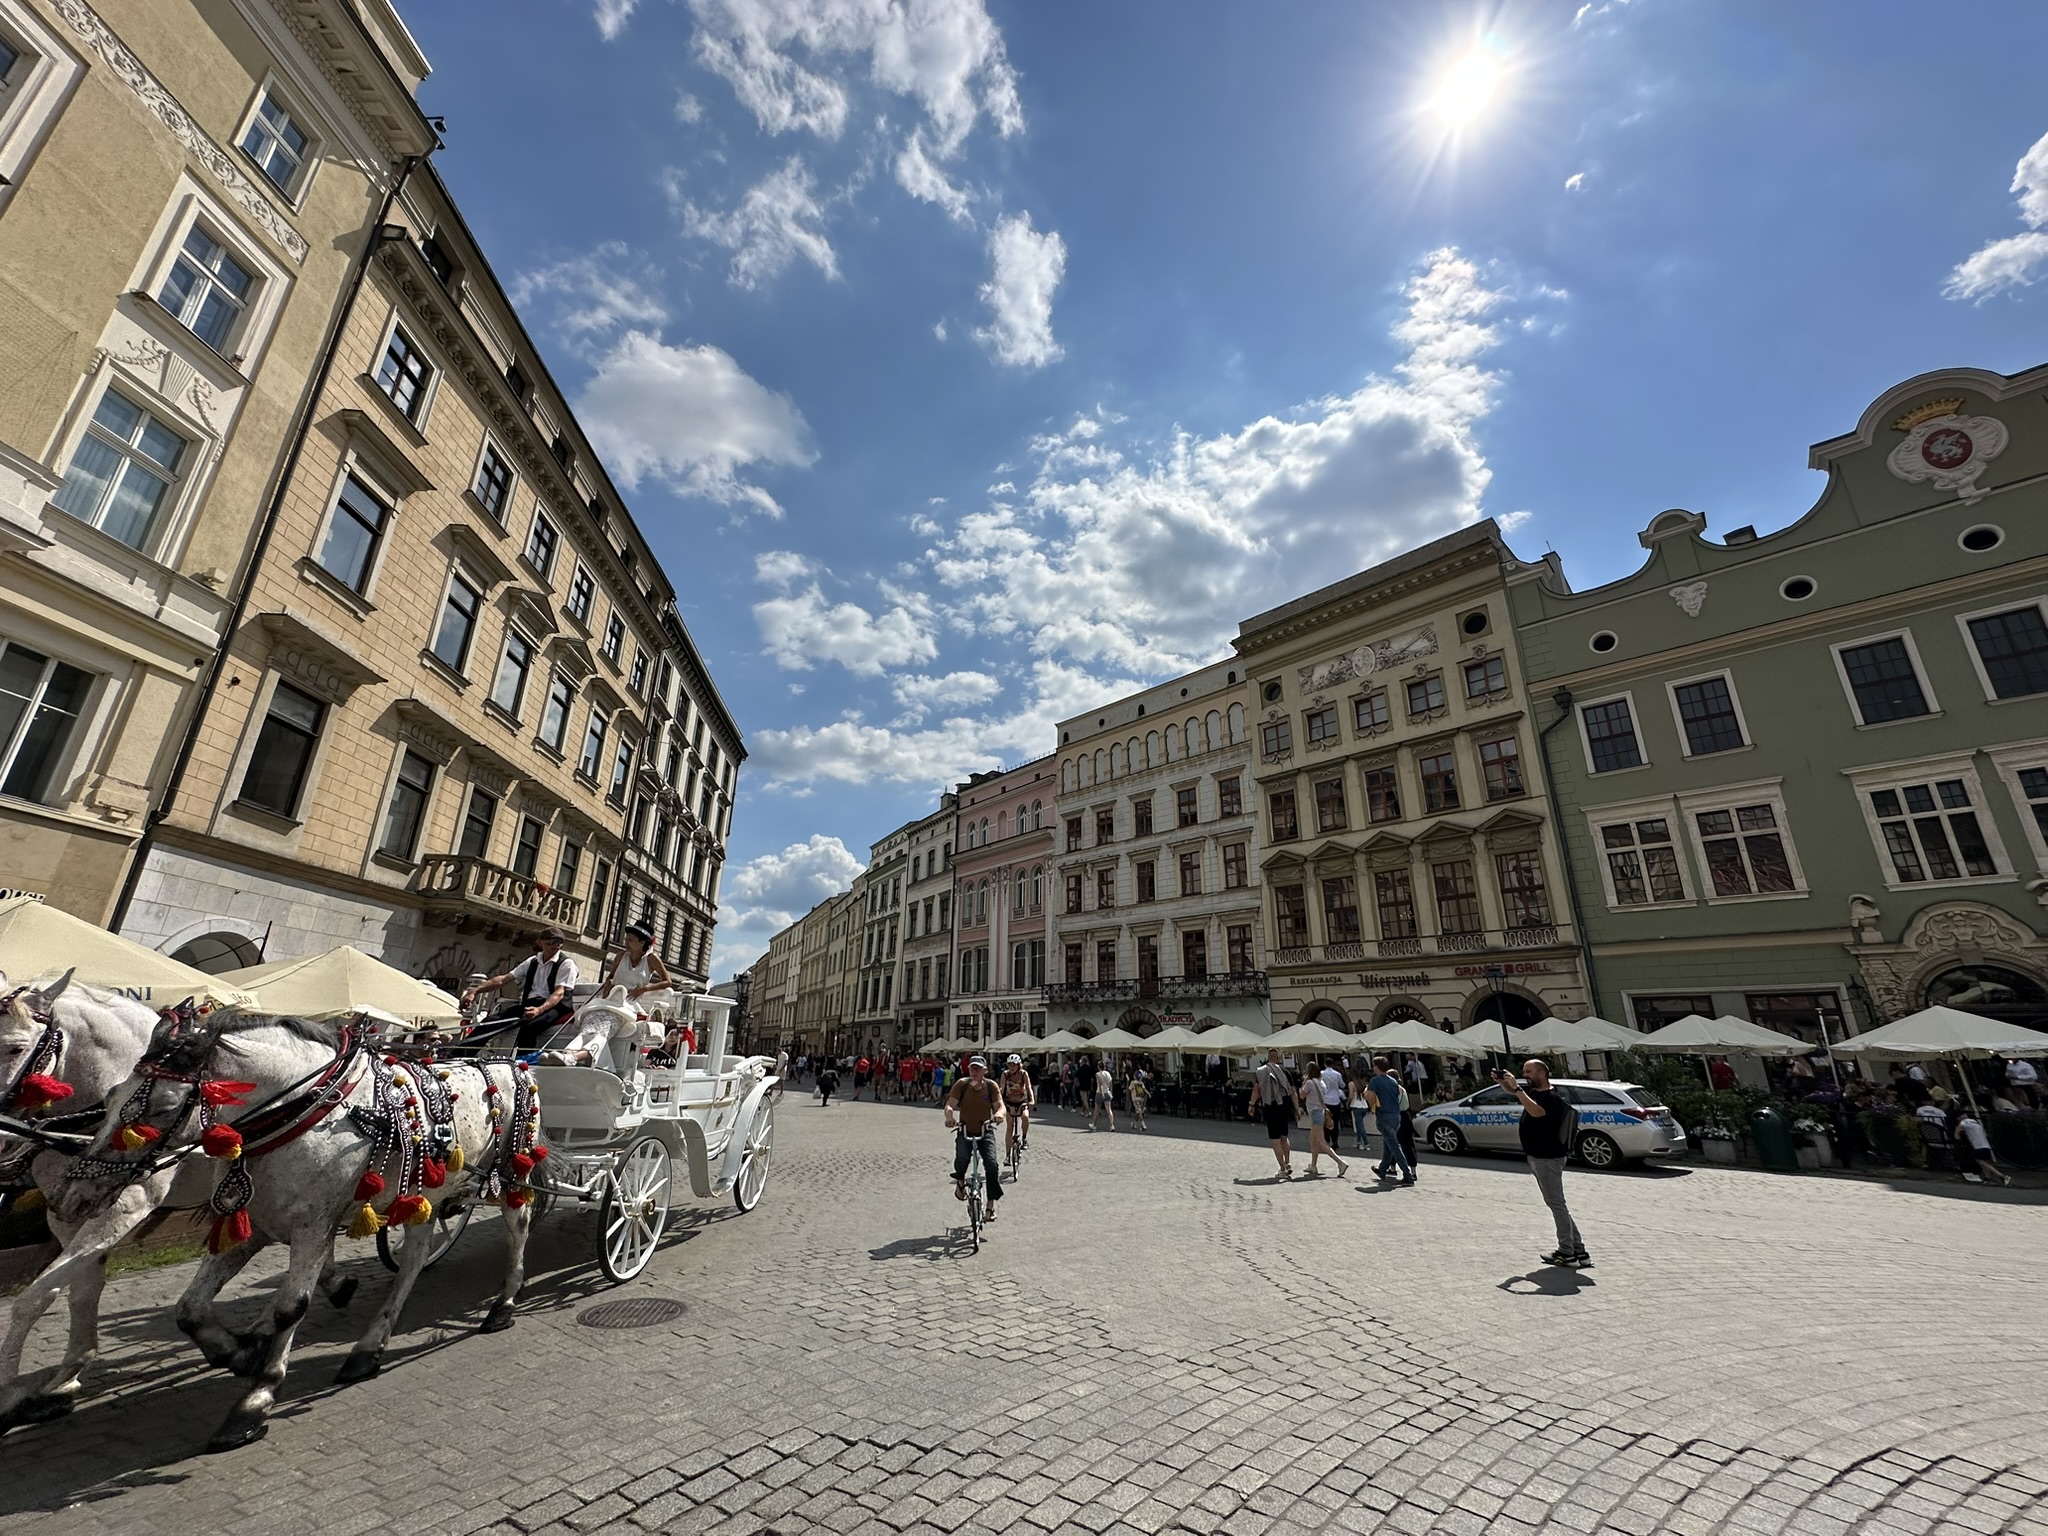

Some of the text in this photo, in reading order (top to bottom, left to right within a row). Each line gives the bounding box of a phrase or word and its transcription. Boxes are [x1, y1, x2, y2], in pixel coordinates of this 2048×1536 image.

[417, 859, 464, 894] 13
[0, 887, 47, 903] OUSE
[555, 897, 572, 925] 13
[1455, 962, 1551, 977] GRAN GRILL
[1356, 971, 1431, 991] Wierzynek
[992, 1001, 1023, 1012] POLONII
[1476, 1114, 1508, 1123] POLICJA
